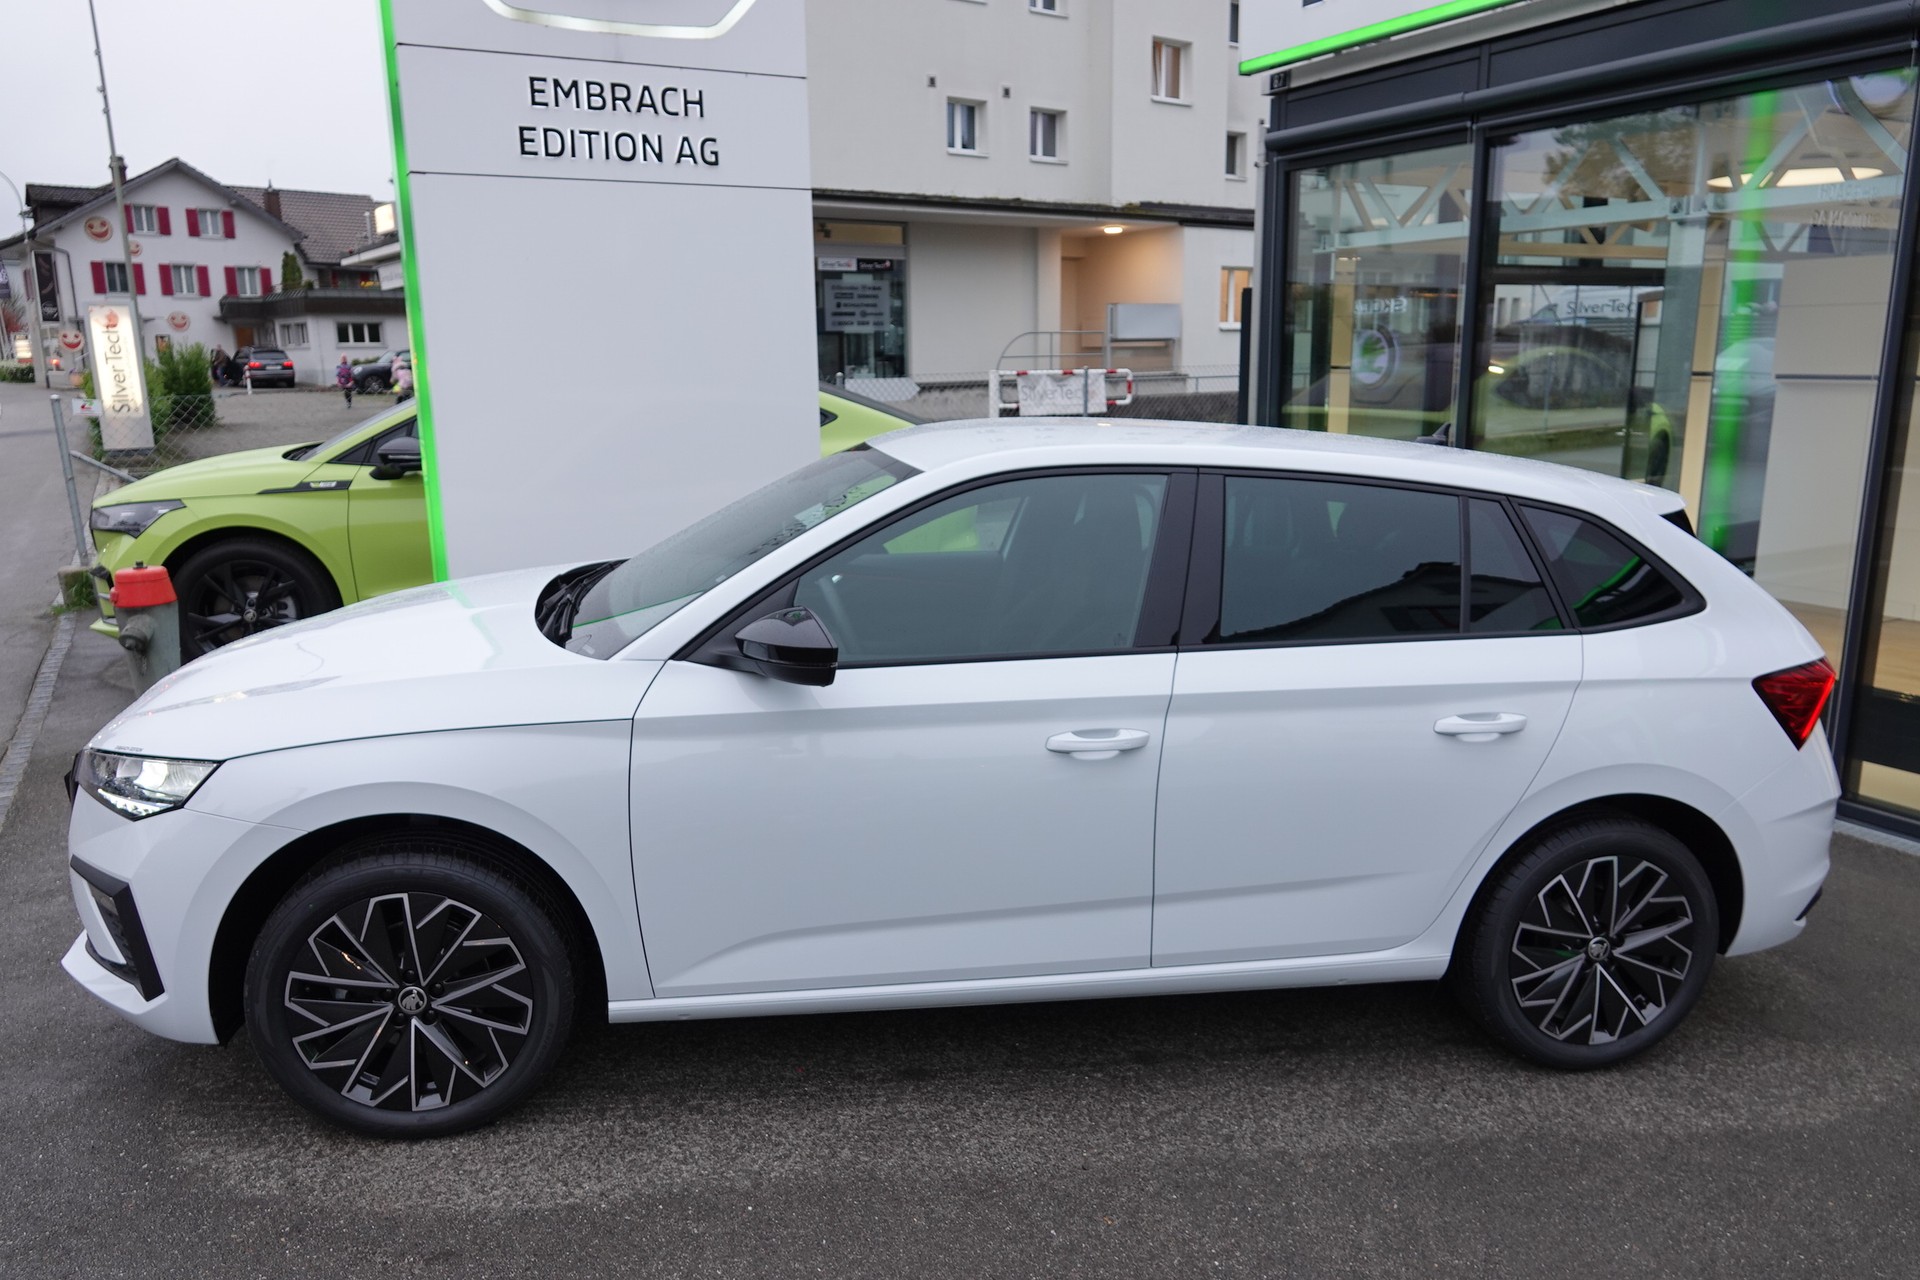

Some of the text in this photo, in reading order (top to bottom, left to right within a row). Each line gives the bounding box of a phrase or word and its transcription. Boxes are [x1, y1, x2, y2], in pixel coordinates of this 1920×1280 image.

[528, 76, 704, 118] EMBRACH
[518, 125, 720, 166] EDITION AG
